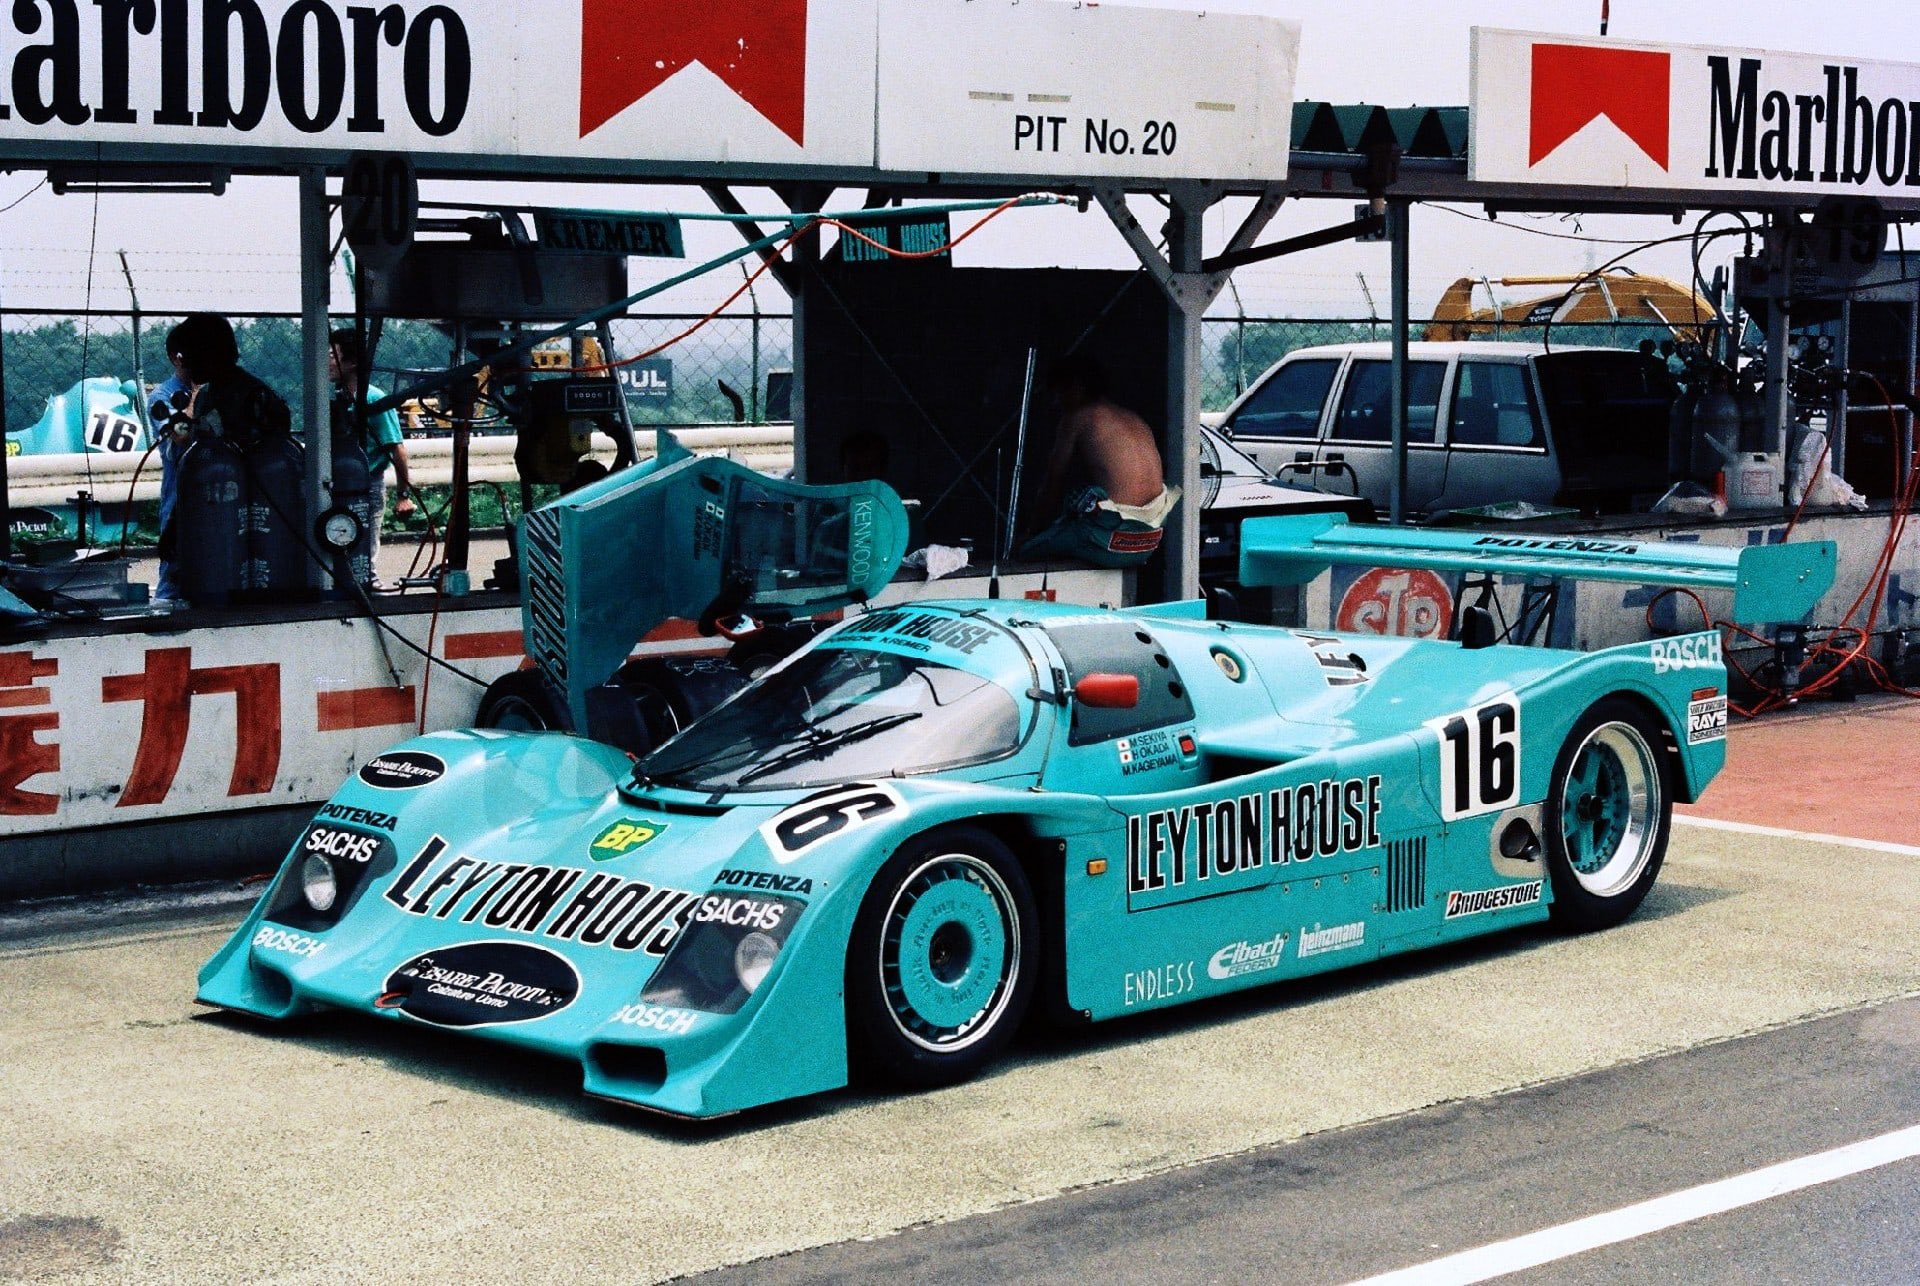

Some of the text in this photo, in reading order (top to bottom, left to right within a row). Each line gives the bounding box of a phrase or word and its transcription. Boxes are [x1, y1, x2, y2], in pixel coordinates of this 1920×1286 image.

[0, 0, 471, 137] arlboro
[1015, 115, 1067, 152] PIT
[1142, 120, 1177, 155] 20
[544, 218, 673, 255] KREMER
[91, 413, 138, 453] 16
[851, 500, 872, 585] KENWOOD
[1473, 537, 1639, 555] POTENZA
[879, 637, 932, 653] KREMER
[894, 613, 1000, 655] HOUSE
[1650, 632, 1723, 675] BOSCH
[1690, 711, 1727, 733] RAYS
[1442, 702, 1516, 813] 16
[319, 803, 398, 832] POTENZA
[1128, 774, 1382, 893] LEYTON HOUSE
[305, 828, 379, 863] SACHS
[594, 823, 655, 851] BP
[384, 834, 584, 933] LEYTON
[713, 869, 813, 895] POTENZA
[1447, 882, 1541, 917] BRIDGESTONE
[695, 896, 785, 930] SACHS
[252, 926, 327, 958] BOSCH
[1124, 960, 1195, 1006] ENDLESS
